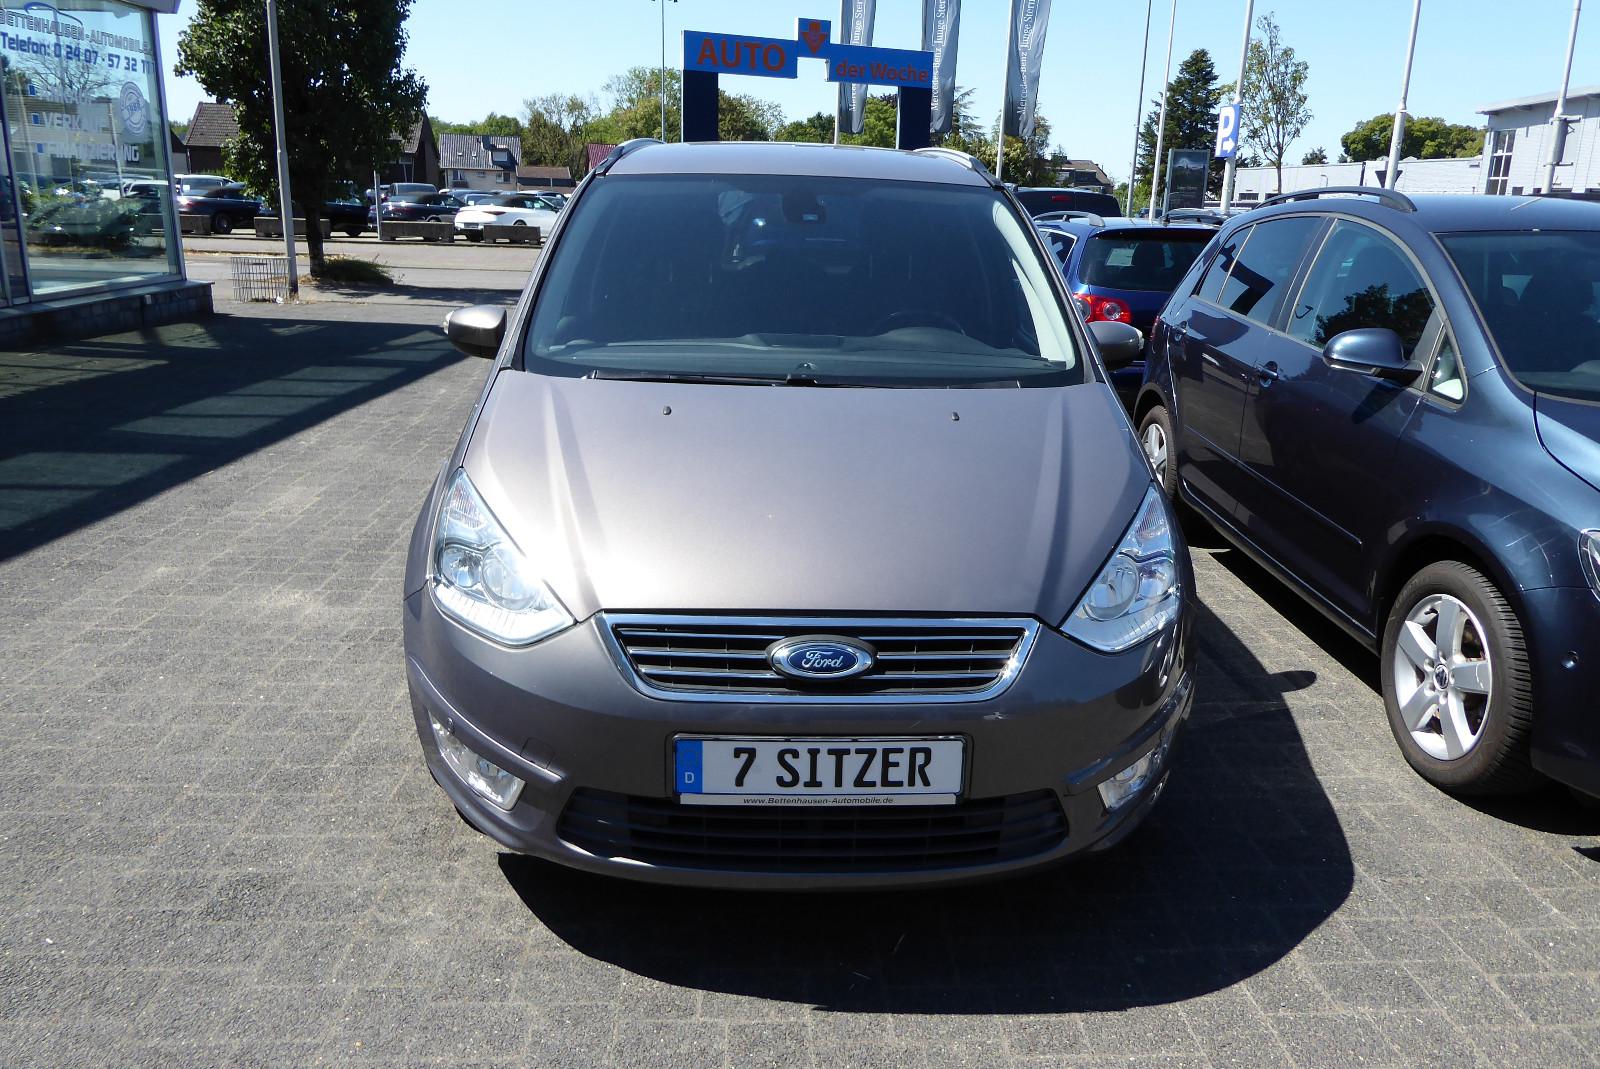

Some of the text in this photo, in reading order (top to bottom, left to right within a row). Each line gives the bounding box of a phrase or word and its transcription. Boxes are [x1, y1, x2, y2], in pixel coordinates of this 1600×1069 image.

[855, 0, 865, 19] Ster
[936, 0, 946, 18] Ster
[934, 20, 946, 44] Junge
[1020, 24, 1033, 48] Junge
[0, 31, 51, 57] Telefon:
[54, 42, 62, 58] 0
[66, 44, 80, 62] 24
[84, 48, 98, 65] 07
[107, 52, 121, 69] 57
[124, 56, 138, 72] 32
[697, 37, 929, 83] AUTO der Woche
[1215, 106, 1235, 157] P
[801, 650, 843, 668] Ford
[684, 771, 695, 784] D
[733, 746, 932, 788] 7 SITZER
[743, 797, 894, 805] www.Bettenhausen-Automobile.de
